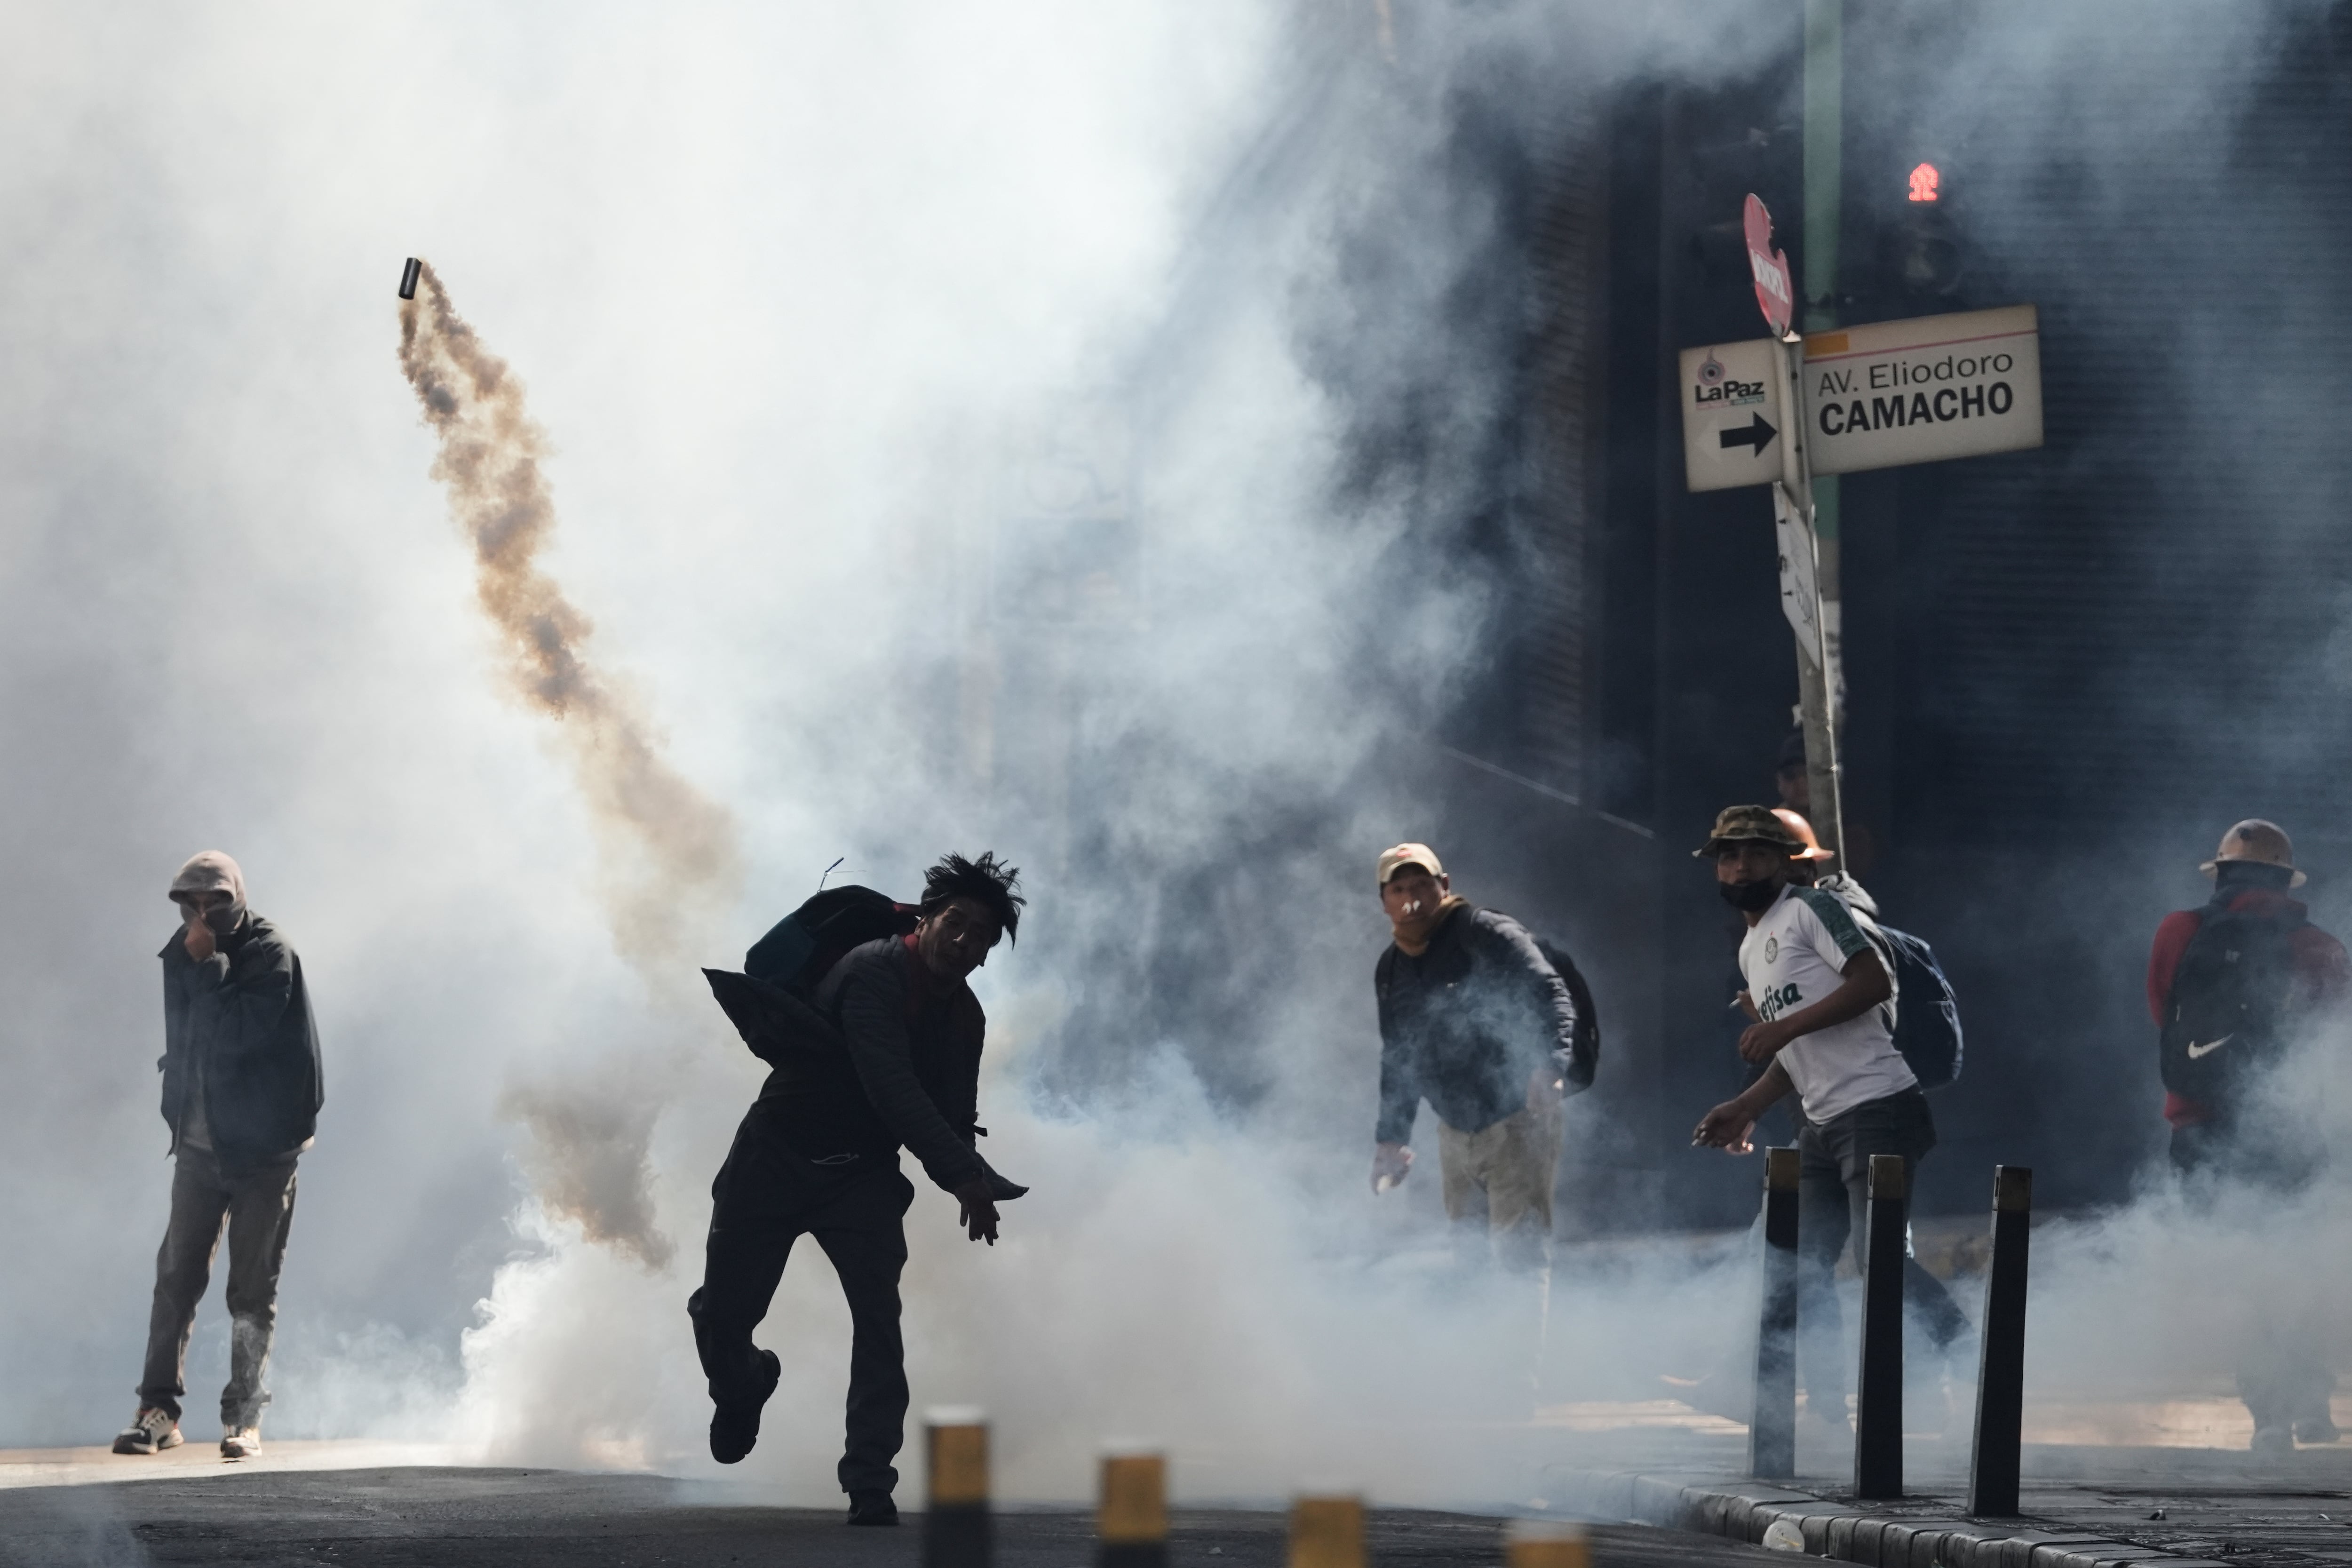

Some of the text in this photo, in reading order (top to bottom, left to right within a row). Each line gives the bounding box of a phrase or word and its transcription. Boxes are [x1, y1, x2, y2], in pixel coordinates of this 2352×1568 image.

[1819, 353, 2013, 397] AV. Eliodoro
[1819, 382, 2013, 435] CAMACHO
